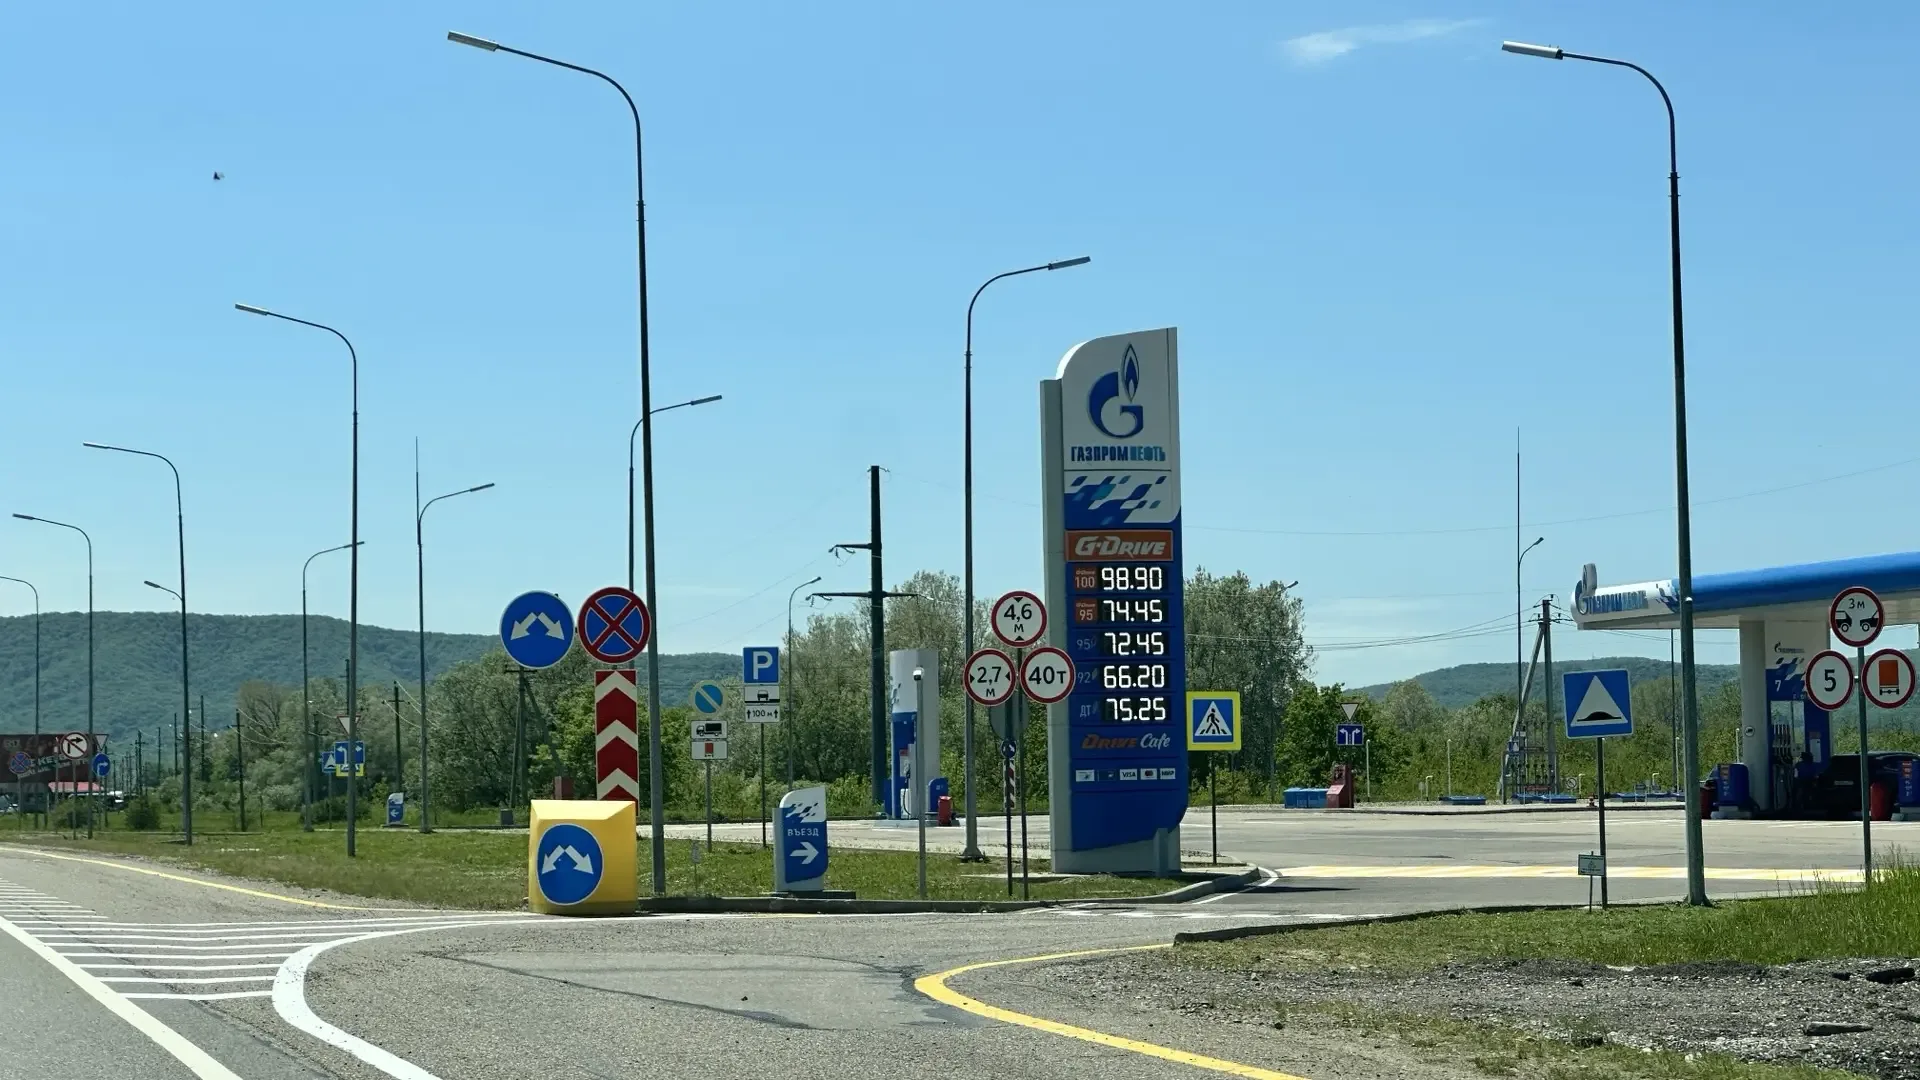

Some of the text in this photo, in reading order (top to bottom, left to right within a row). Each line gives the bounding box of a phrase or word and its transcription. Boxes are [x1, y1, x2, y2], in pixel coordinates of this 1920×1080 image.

[1071, 445, 1166, 461] ГАЗПРОМНЕФТЬ
[1075, 567, 1163, 590] 100 98.90
[1003, 603, 1032, 622] 4,6
[1079, 600, 1163, 623] 95 74.45
[1076, 632, 1164, 656] 95 72.45
[977, 666, 1002, 685] 2,7
[1077, 665, 1165, 689] 92 66.20
[1824, 669, 1837, 692] 5
[1774, 680, 1782, 692] 7
[753, 709, 766, 717] 100
[1079, 697, 1166, 721] ДТ 75.25
[1140, 733, 1171, 750] Cafe
[787, 828, 819, 837] ВЪЕЗД
